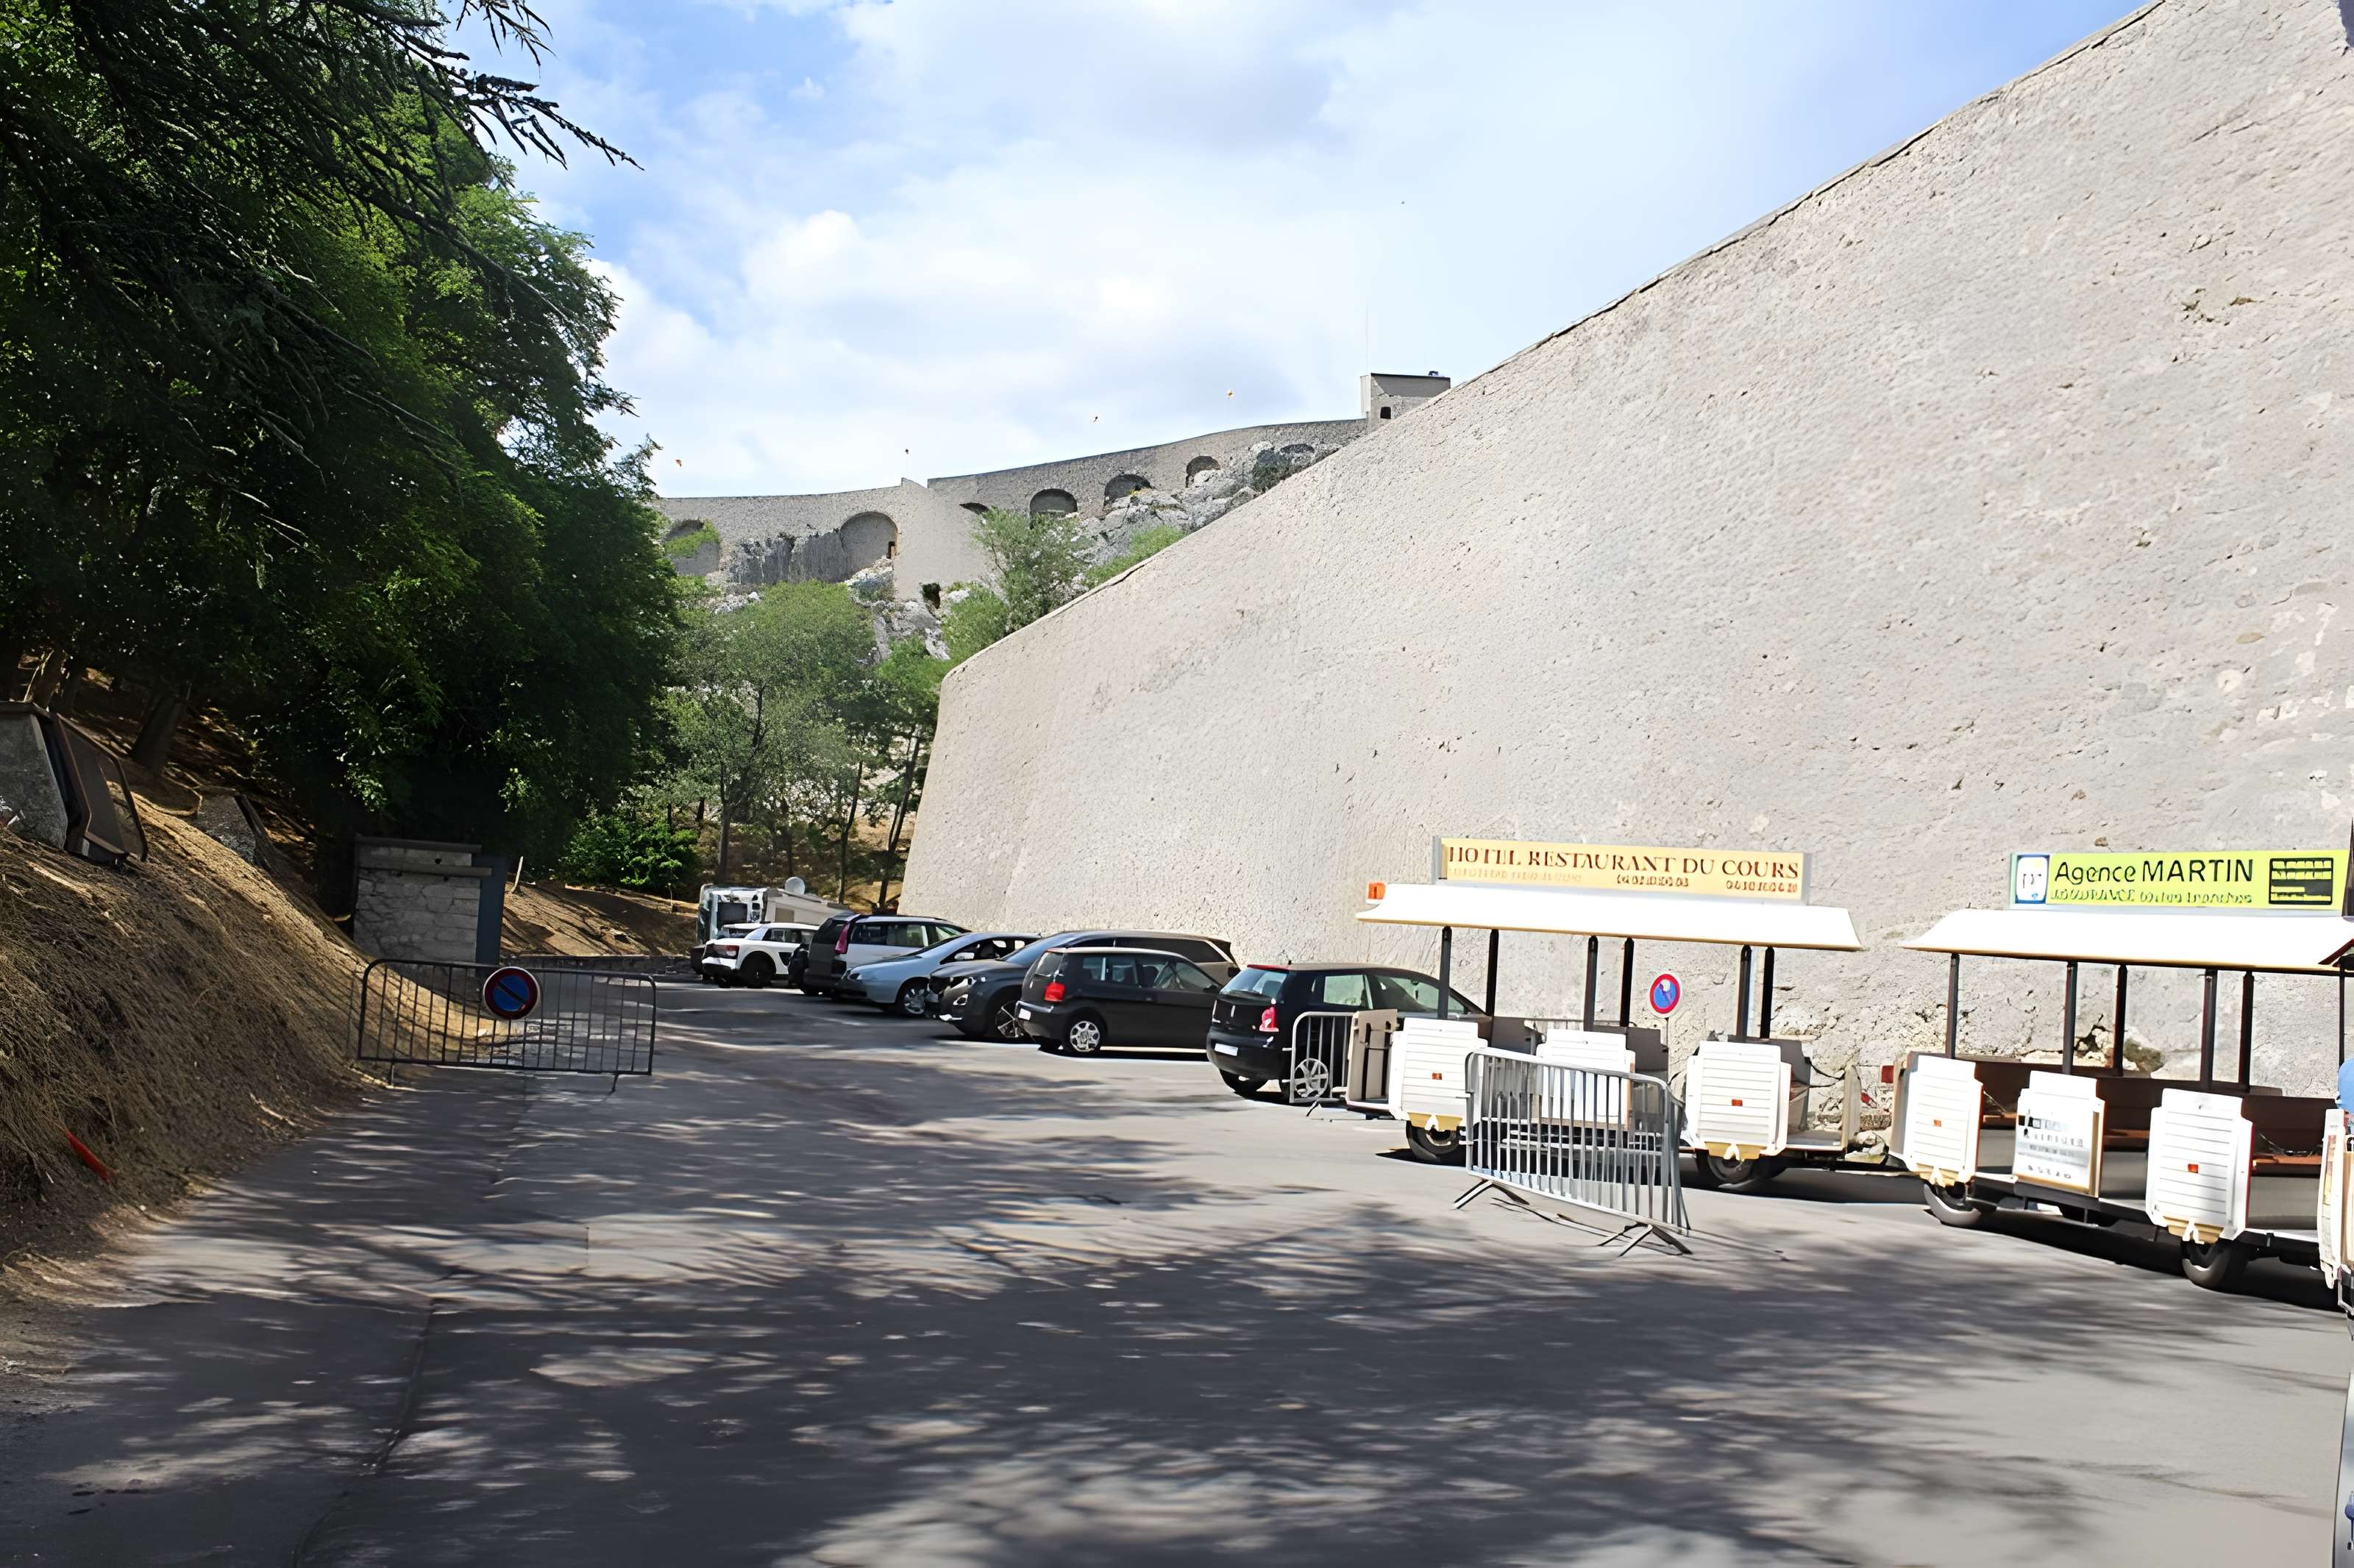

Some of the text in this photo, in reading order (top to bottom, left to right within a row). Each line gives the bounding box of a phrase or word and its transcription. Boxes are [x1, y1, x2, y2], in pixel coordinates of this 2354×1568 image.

[1449, 847, 1799, 879] HOTEL RESTAURANT DU COURS
[2055, 861, 2136, 885] Agence
[2142, 858, 2253, 883] MARTIN
